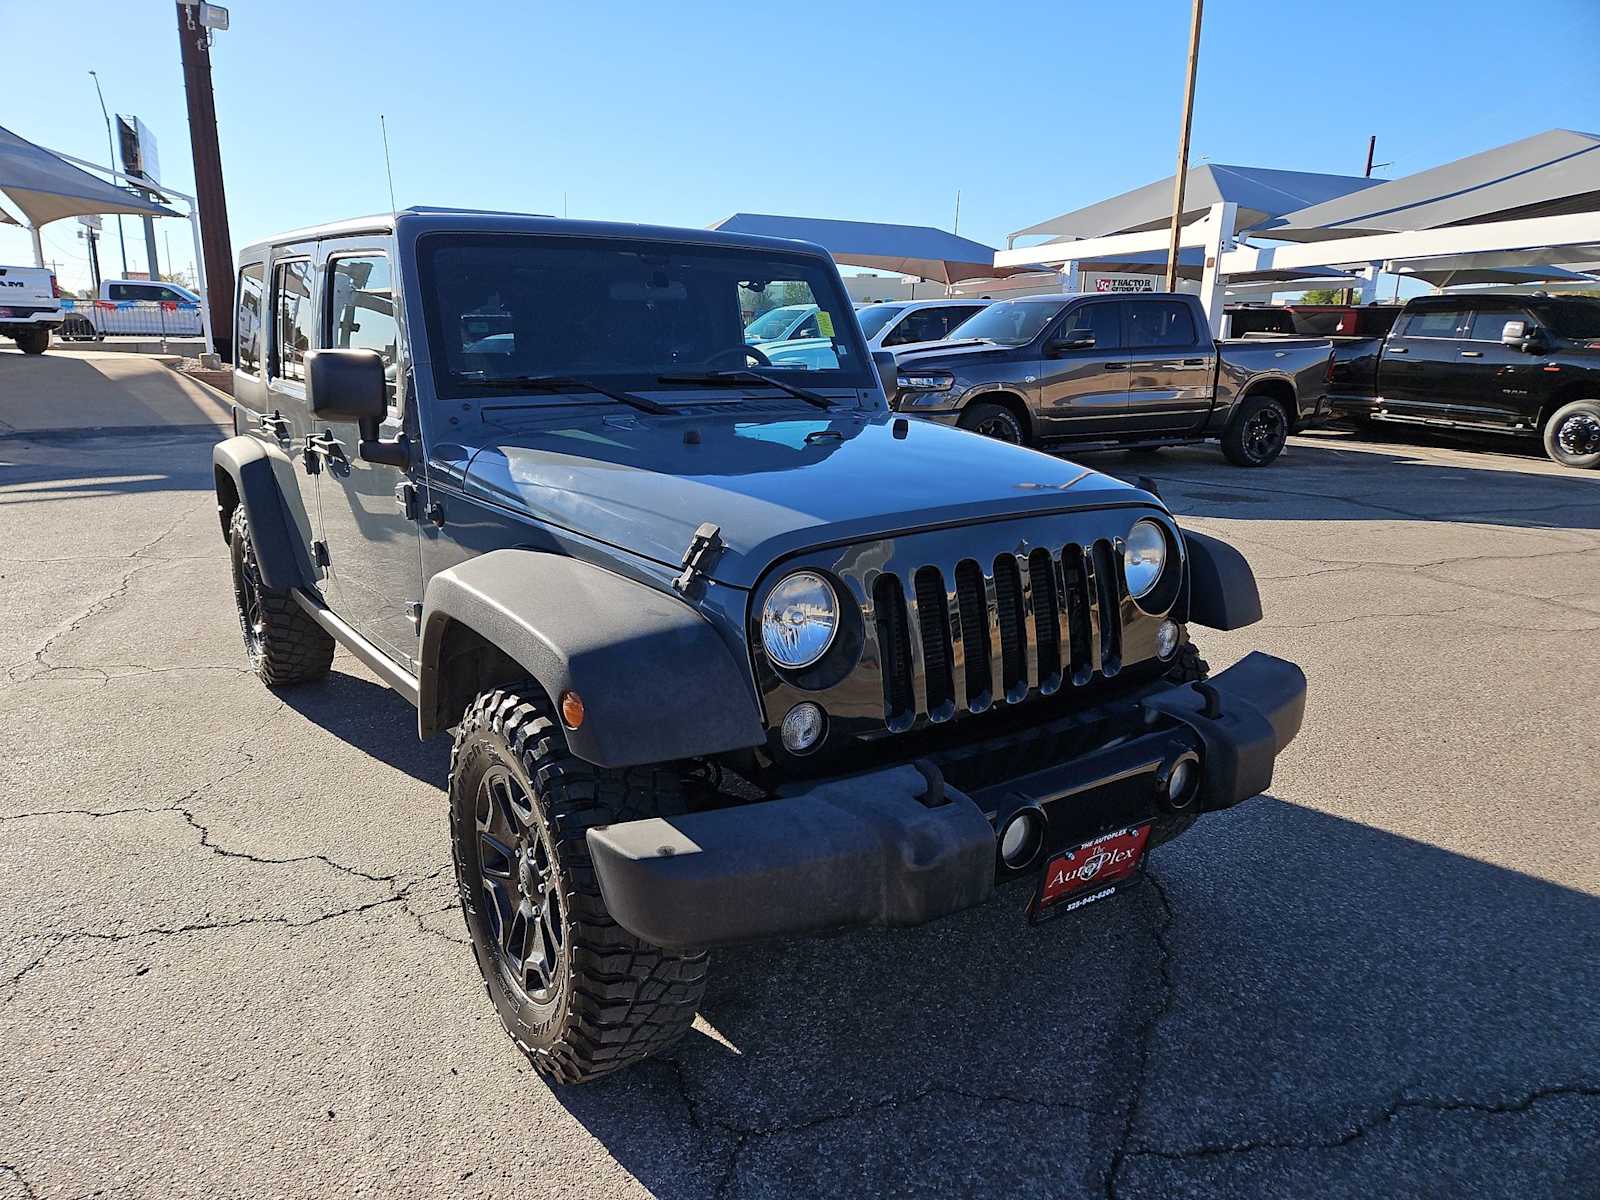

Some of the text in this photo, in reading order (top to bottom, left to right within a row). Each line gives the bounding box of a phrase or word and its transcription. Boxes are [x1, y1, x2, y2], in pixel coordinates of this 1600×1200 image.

[1096, 279, 1110, 291] TSC
[1111, 279, 1151, 287] TRACTOR
[1080, 828, 1128, 850] THE AUTOPLEX
